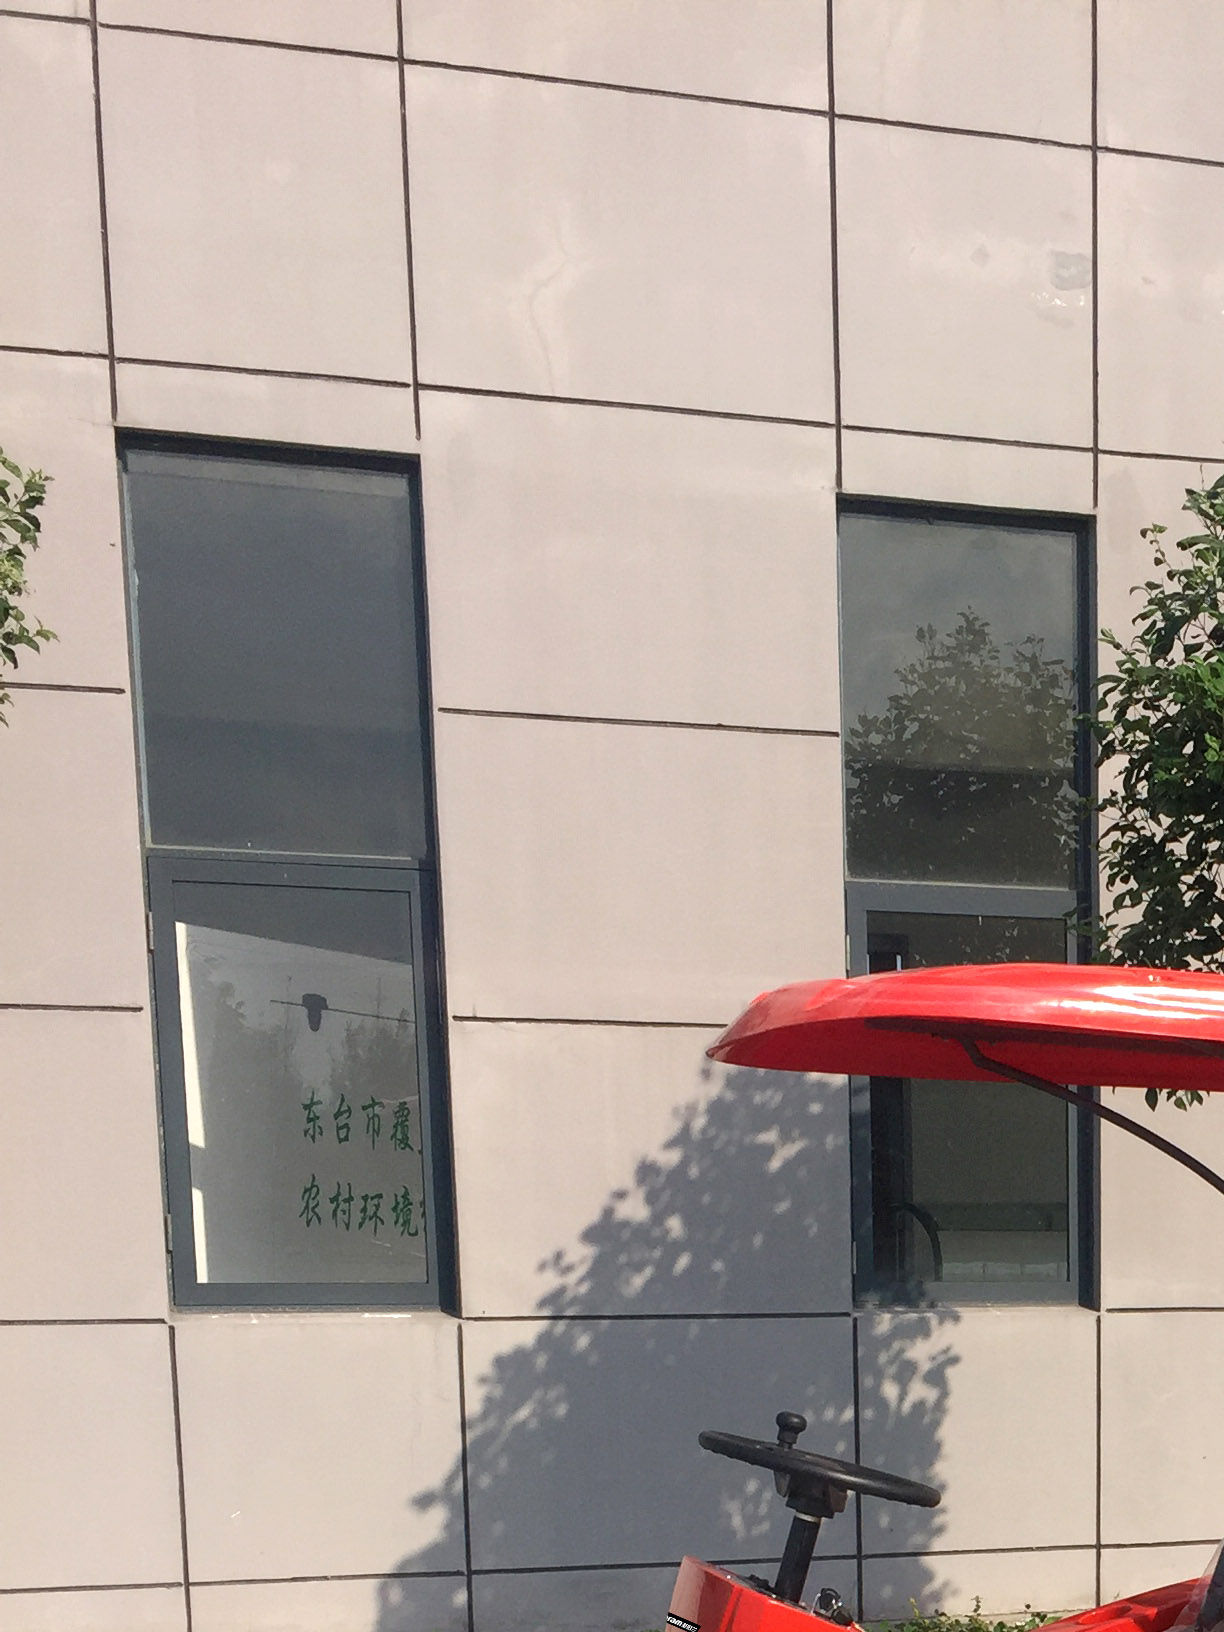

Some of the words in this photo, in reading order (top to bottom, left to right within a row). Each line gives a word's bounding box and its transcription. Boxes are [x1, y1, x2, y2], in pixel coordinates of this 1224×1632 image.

[301, 1088, 422, 1155] 东台市覆
[298, 1173, 425, 1237] 农村环境
